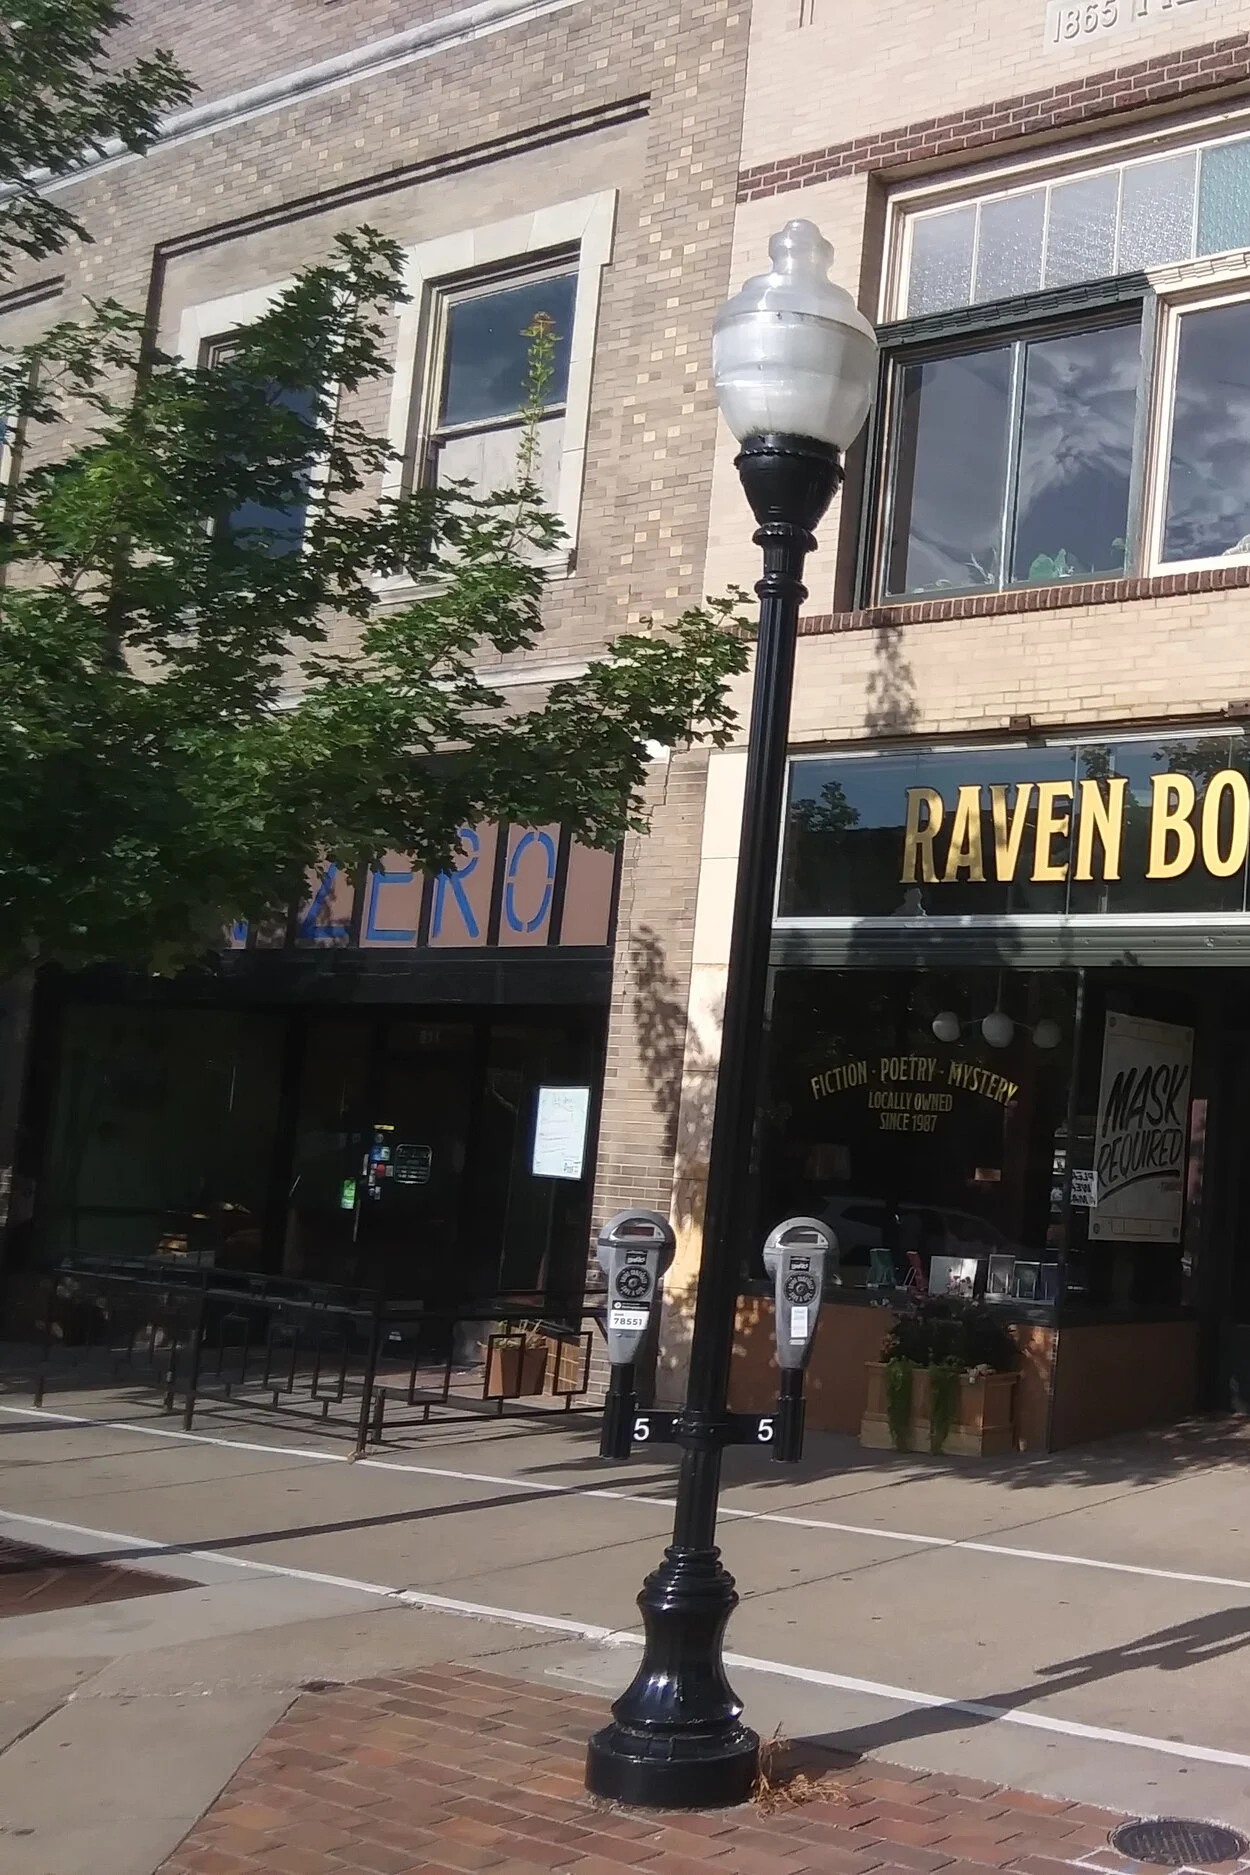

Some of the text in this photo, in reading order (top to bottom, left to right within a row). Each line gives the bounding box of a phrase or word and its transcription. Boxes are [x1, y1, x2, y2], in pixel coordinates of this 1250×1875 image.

[900, 776, 1129, 884] RAVEN
[811, 1056, 1019, 1106] FICTION POETRY MYSTERY
[868, 1092, 953, 1111] LOCALLY OWNED
[1102, 1063, 1189, 1138] MASK
[880, 1112, 937, 1133] SINCE 1987
[1099, 1128, 1184, 1187] REQUIRED
[613, 1317, 643, 1327] 78551
[633, 1417, 650, 1441] 5
[758, 1418, 774, 1442] 5
